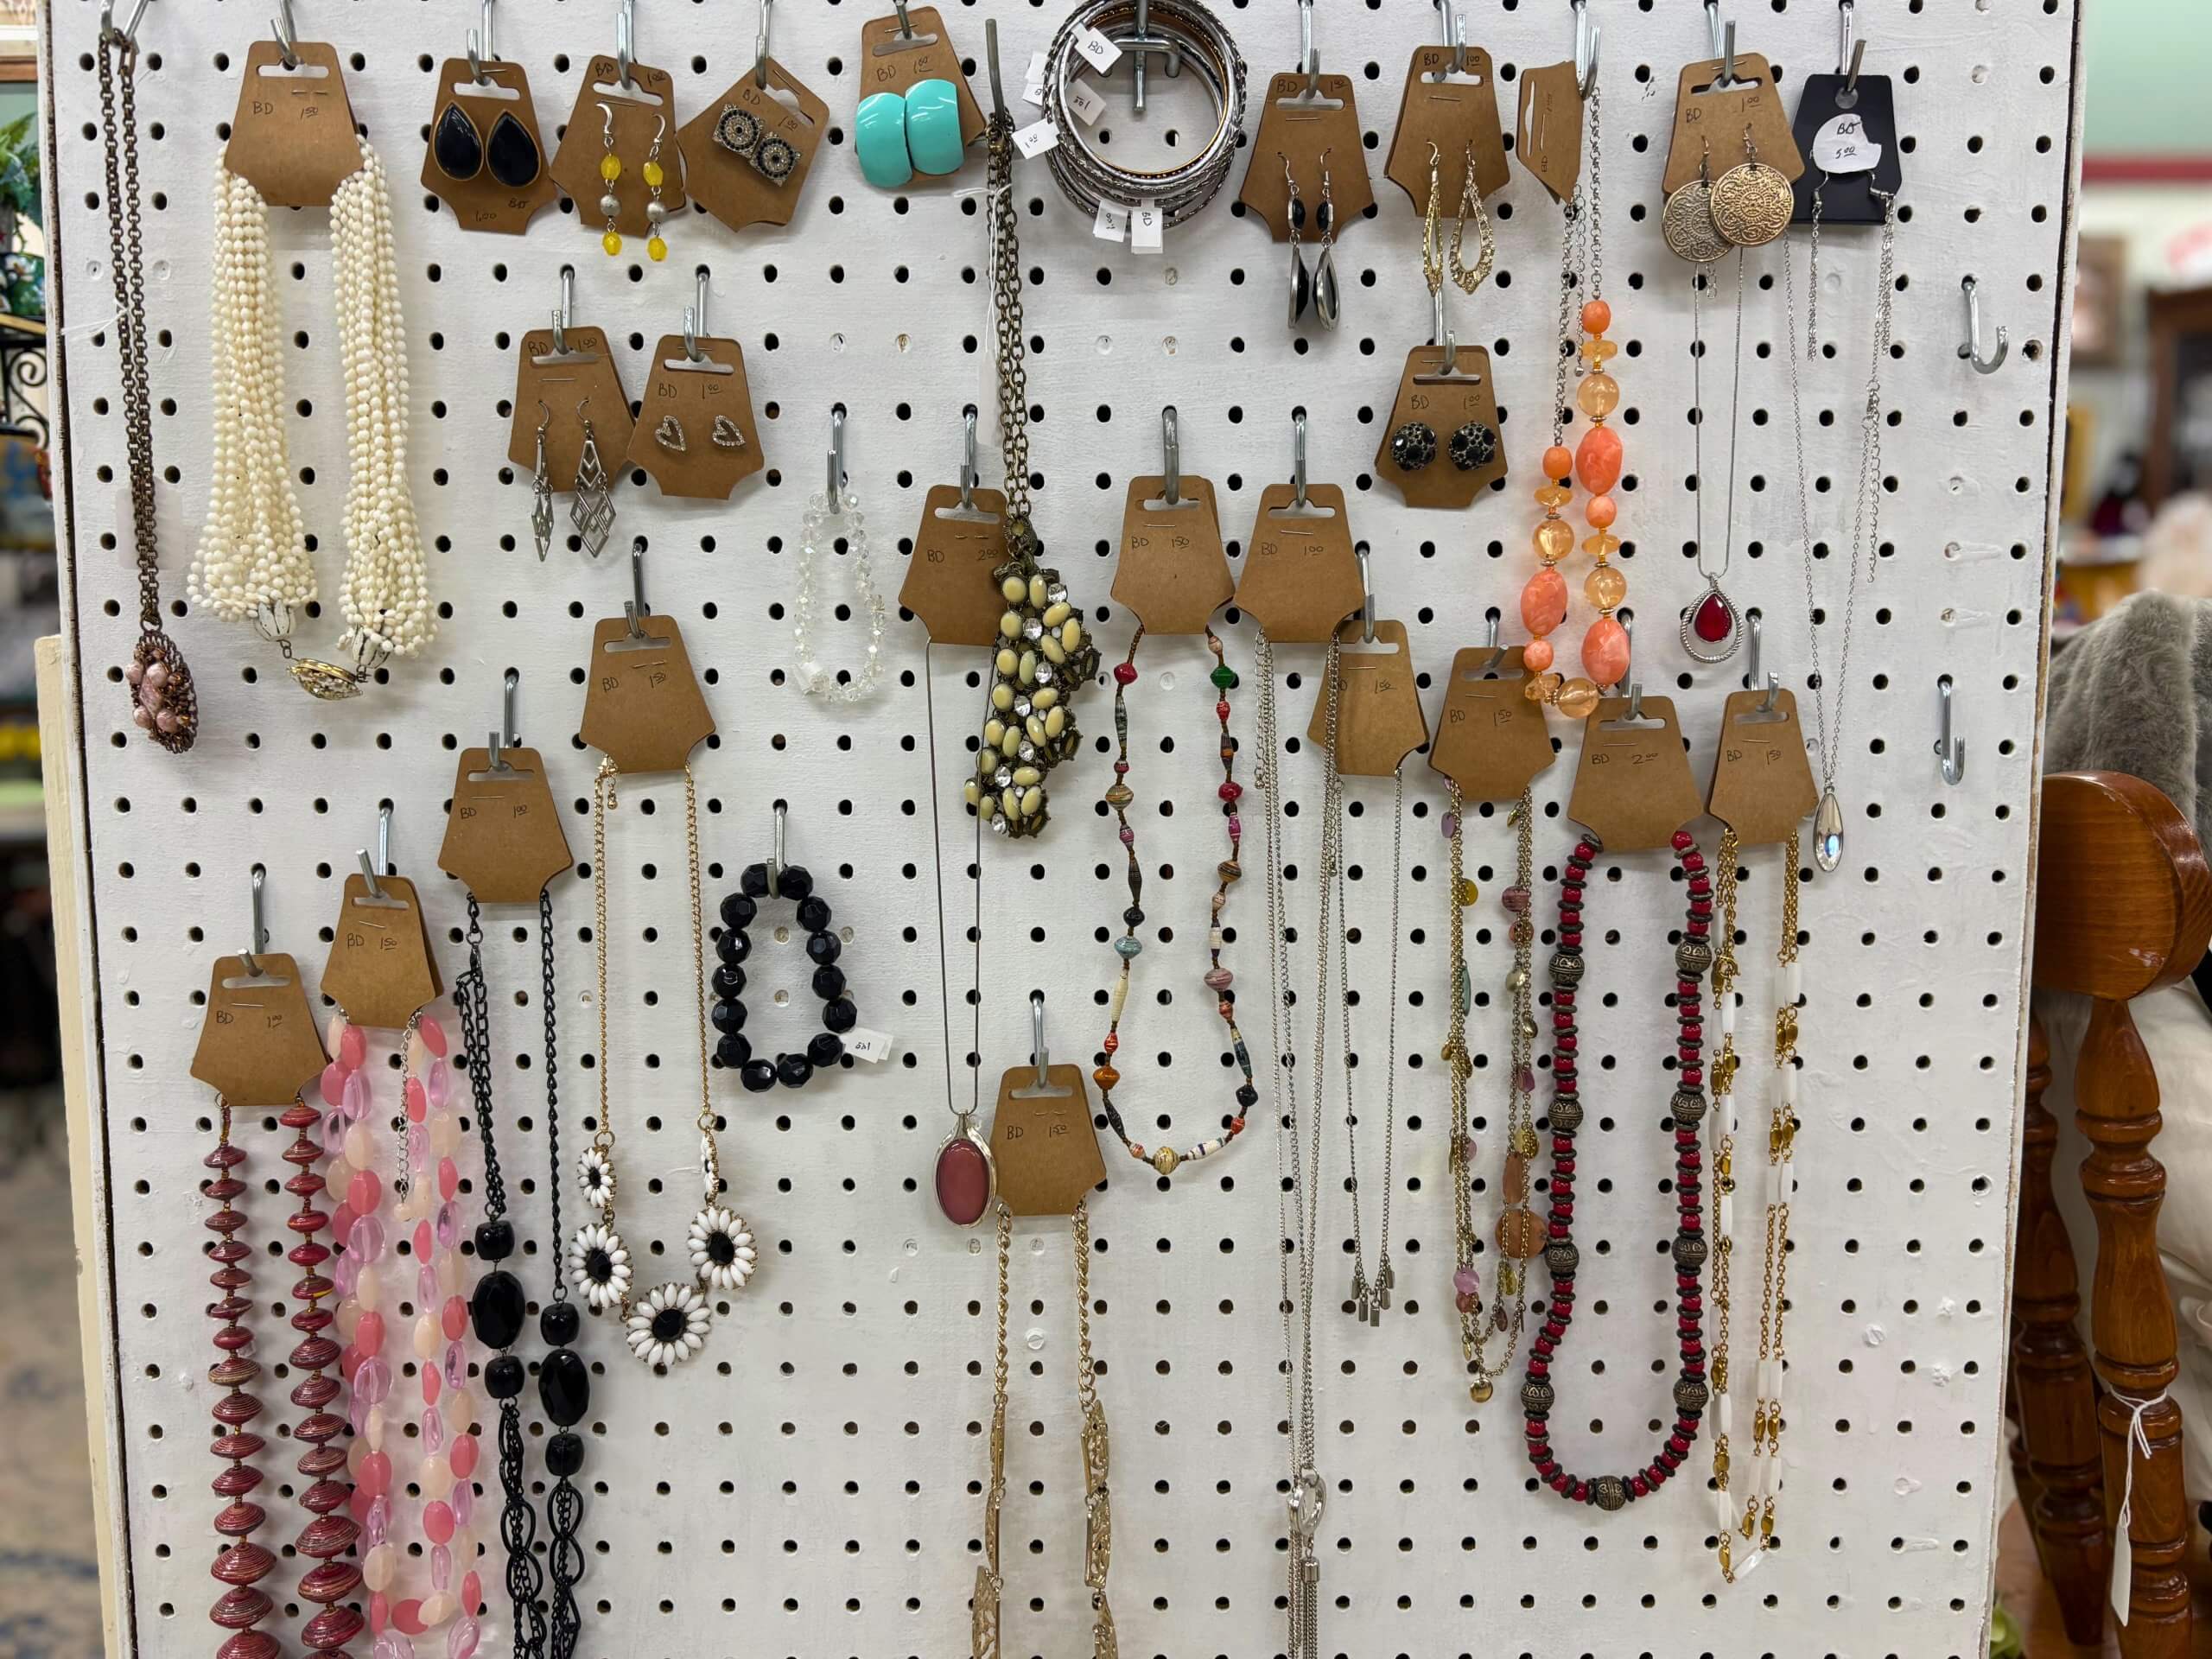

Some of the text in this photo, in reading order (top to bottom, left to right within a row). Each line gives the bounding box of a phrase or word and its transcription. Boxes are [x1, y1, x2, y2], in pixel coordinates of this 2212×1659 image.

[1088, 41, 1103, 54] BD
[1424, 54, 1439, 66] BD
[877, 64, 897, 81] BD
[1277, 79, 1298, 92] BD
[742, 89, 760, 105] BD
[253, 101, 273, 116] BD
[1686, 108, 1701, 122] BD
[1838, 122, 1860, 135] BD
[508, 197, 530, 209] BD
[1141, 212, 1153, 226] BD
[529, 340, 548, 355] BD
[658, 384, 677, 397] BD
[1411, 395, 1429, 409] BD
[1132, 537, 1148, 550] BD
[1261, 543, 1277, 555] BD
[927, 550, 944, 563] BD
[603, 677, 619, 692] BD
[1450, 710, 1465, 723] BD
[1592, 753, 1609, 765] BD
[1727, 750, 1742, 761] BD
[461, 807, 476, 819] BD
[347, 933, 365, 948] BD
[217, 1011, 233, 1024] BD
[1007, 1126, 1023, 1140] BD
